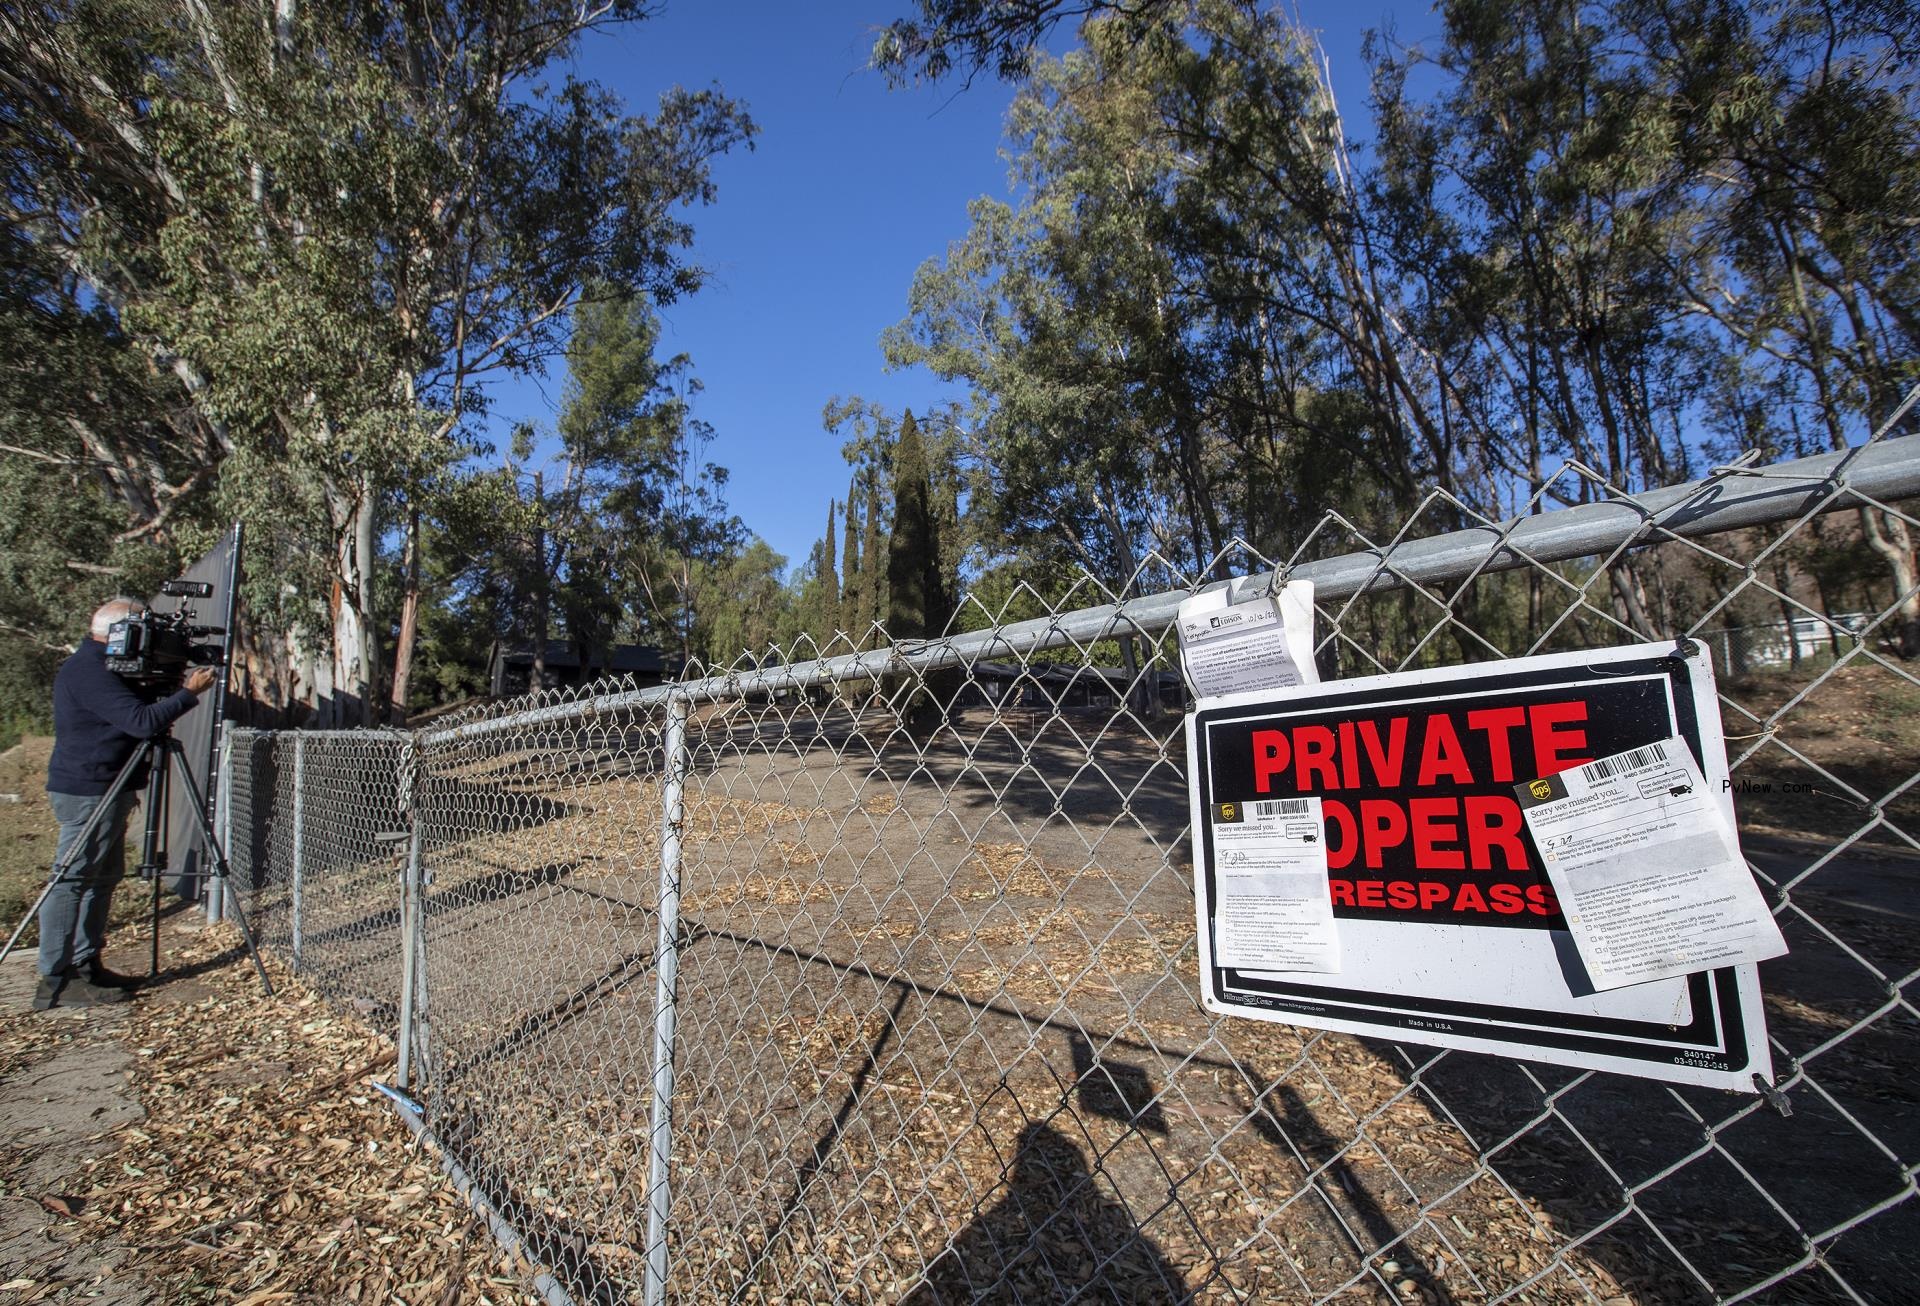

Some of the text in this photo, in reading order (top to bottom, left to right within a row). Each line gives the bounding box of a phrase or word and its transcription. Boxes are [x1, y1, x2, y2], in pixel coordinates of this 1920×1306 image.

[1252, 701, 1595, 793] PRIVATE
[1532, 785, 1550, 797] ups
[1530, 806, 1554, 820] Sorry
[1554, 803, 1568, 811] we
[1567, 792, 1599, 807] missed
[1322, 796, 1530, 870] OPER
[1330, 880, 1562, 916] RESPASS
[1408, 1019, 1424, 1027] Made
[1434, 1022, 1454, 1031] U.S.A.
[1684, 1050, 1716, 1061] 840147
